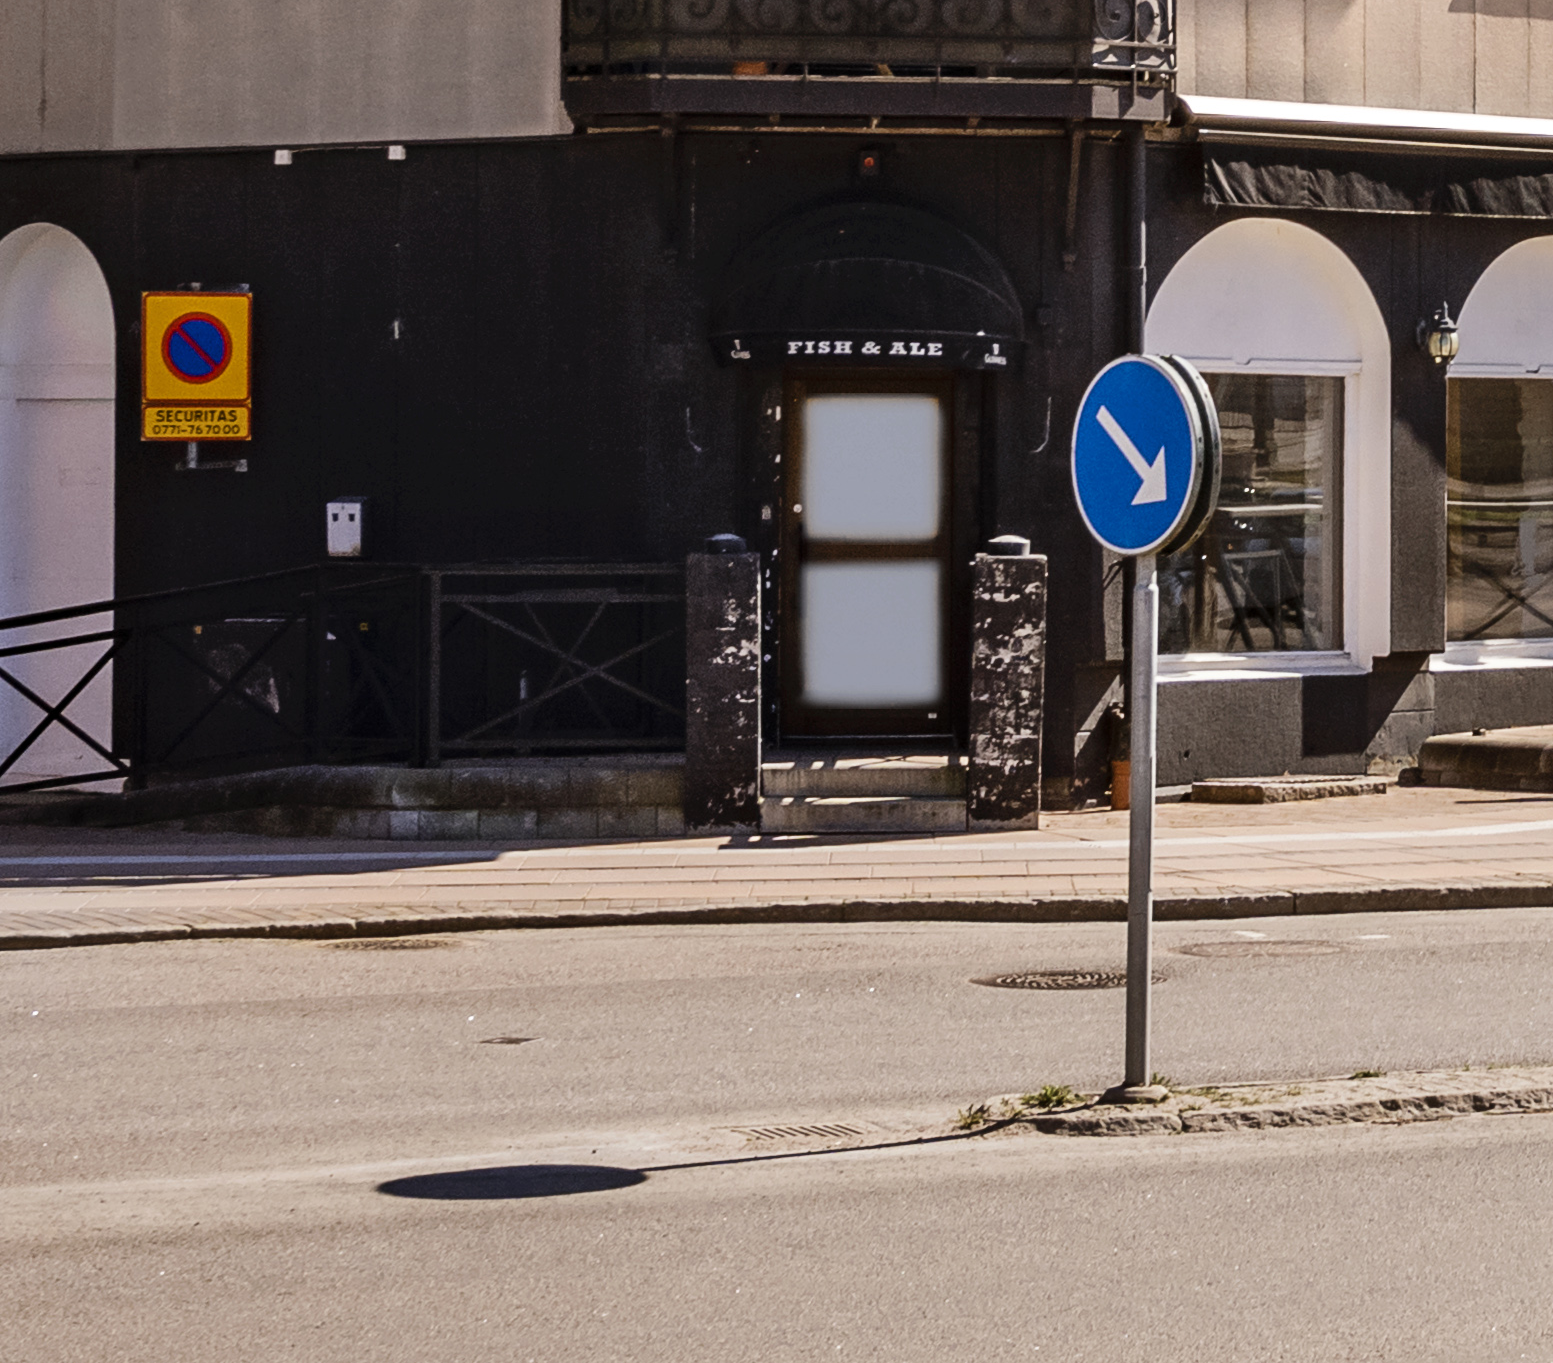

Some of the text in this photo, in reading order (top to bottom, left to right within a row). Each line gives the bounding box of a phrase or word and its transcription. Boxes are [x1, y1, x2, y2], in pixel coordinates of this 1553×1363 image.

[788, 340, 943, 356] FISH & ALE
[155, 410, 238, 422] SECURITAS
[152, 425, 203, 435] 0771-76
